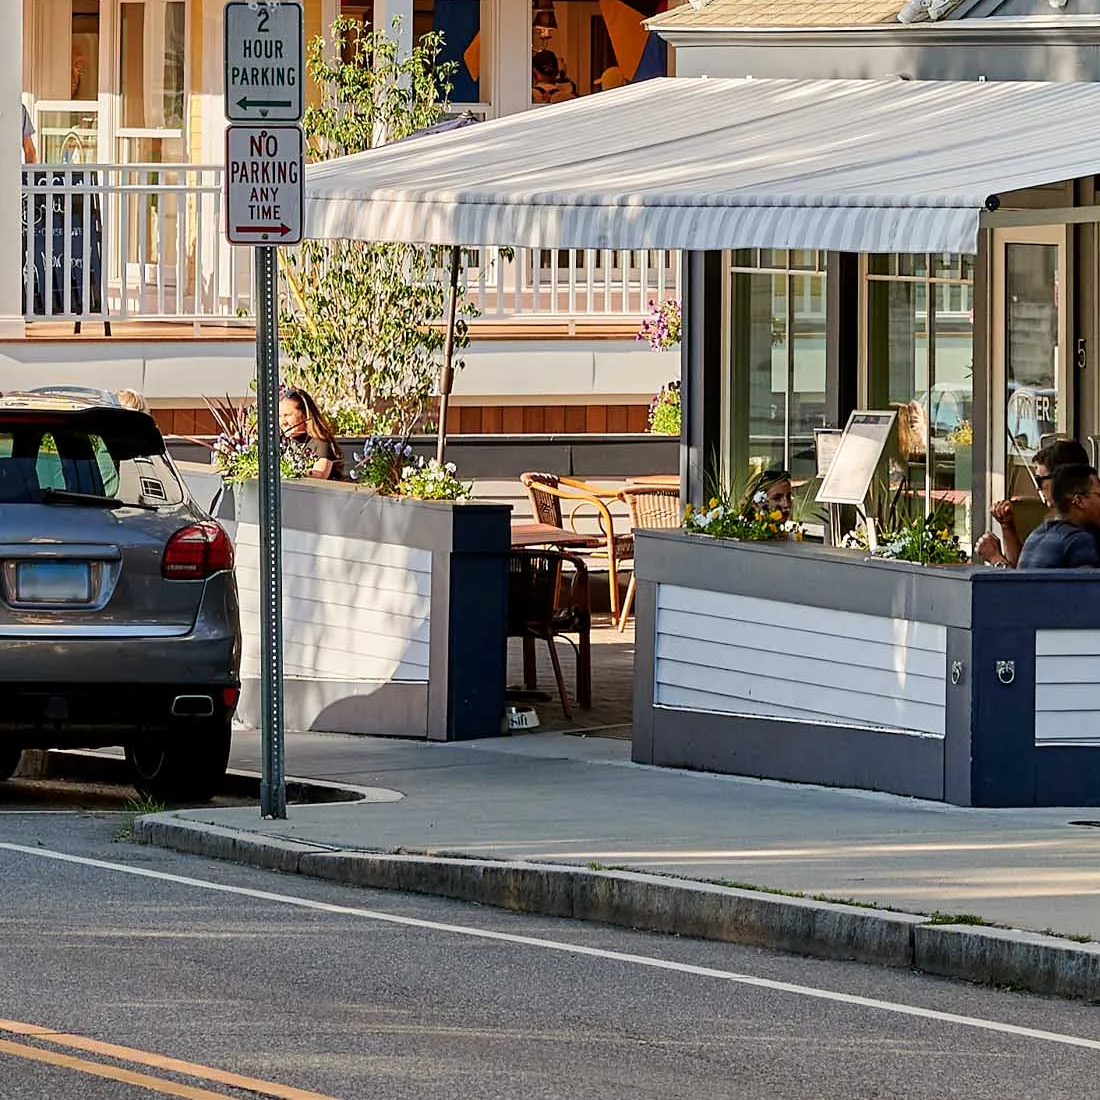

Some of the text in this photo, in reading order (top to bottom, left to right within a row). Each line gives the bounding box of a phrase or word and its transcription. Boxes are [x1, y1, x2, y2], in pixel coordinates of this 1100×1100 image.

[257, 9, 269, 32] 2
[243, 39, 283, 58] HOUR
[232, 67, 296, 86] PARKING
[250, 135, 278, 157] NO
[231, 161, 298, 184] PARKING
[250, 188, 278, 202] ANY
[248, 205, 281, 220] TIME
[1078, 338, 1086, 368] 5
